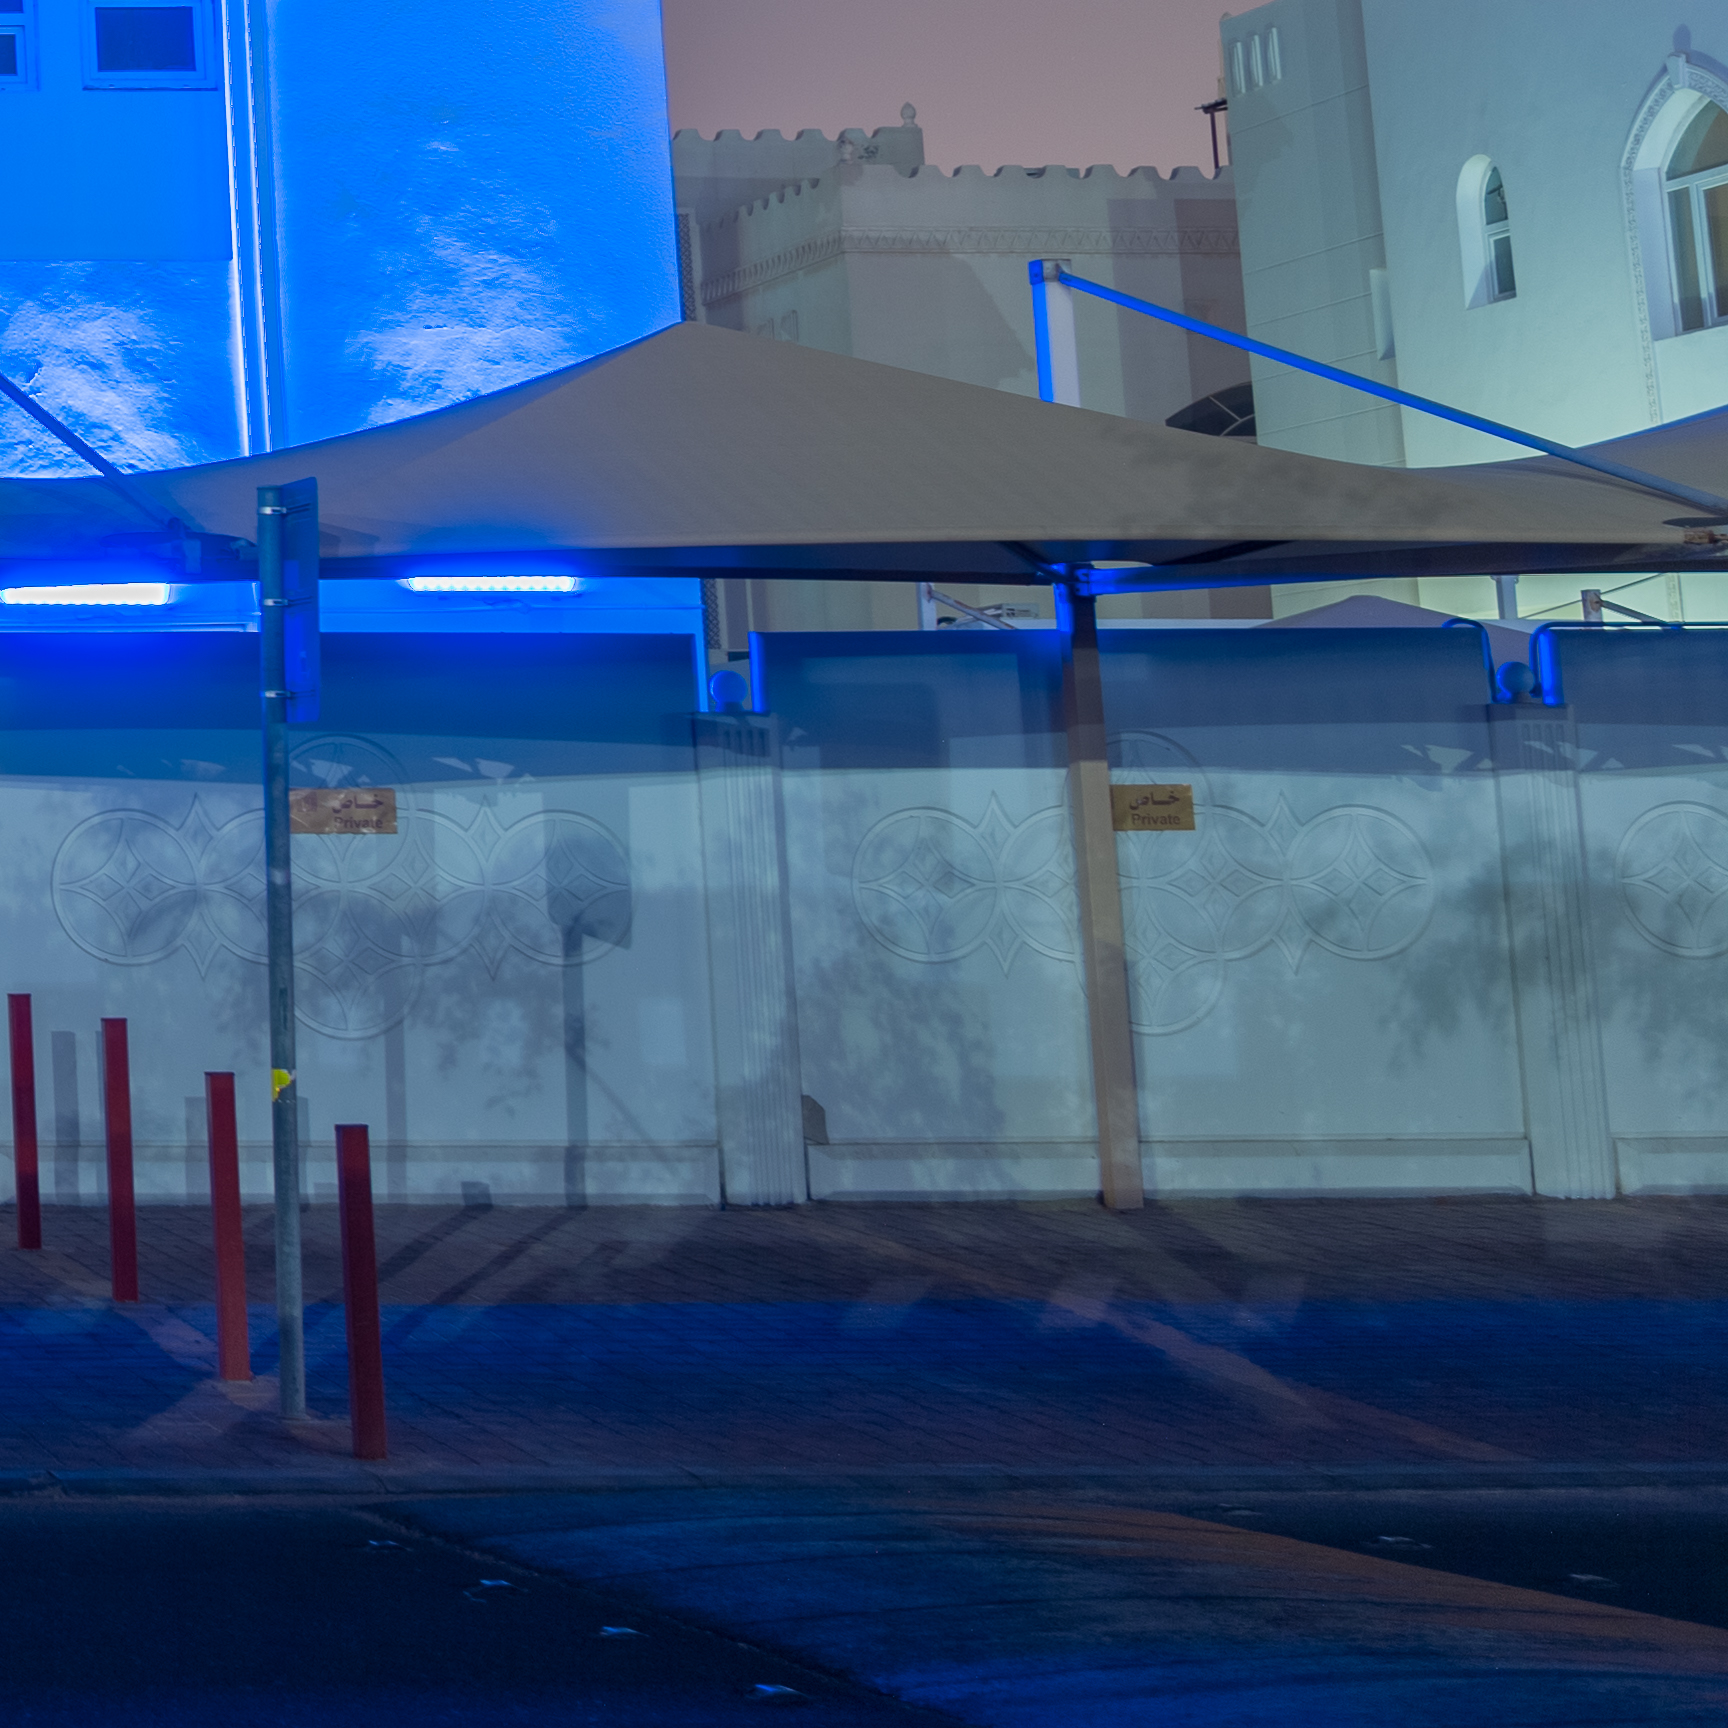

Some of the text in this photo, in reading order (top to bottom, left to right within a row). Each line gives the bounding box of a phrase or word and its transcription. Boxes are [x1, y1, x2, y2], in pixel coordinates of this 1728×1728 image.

[1129, 790, 1180, 811] خاص
[334, 817, 383, 828] Private
[1132, 813, 1181, 825] Private
